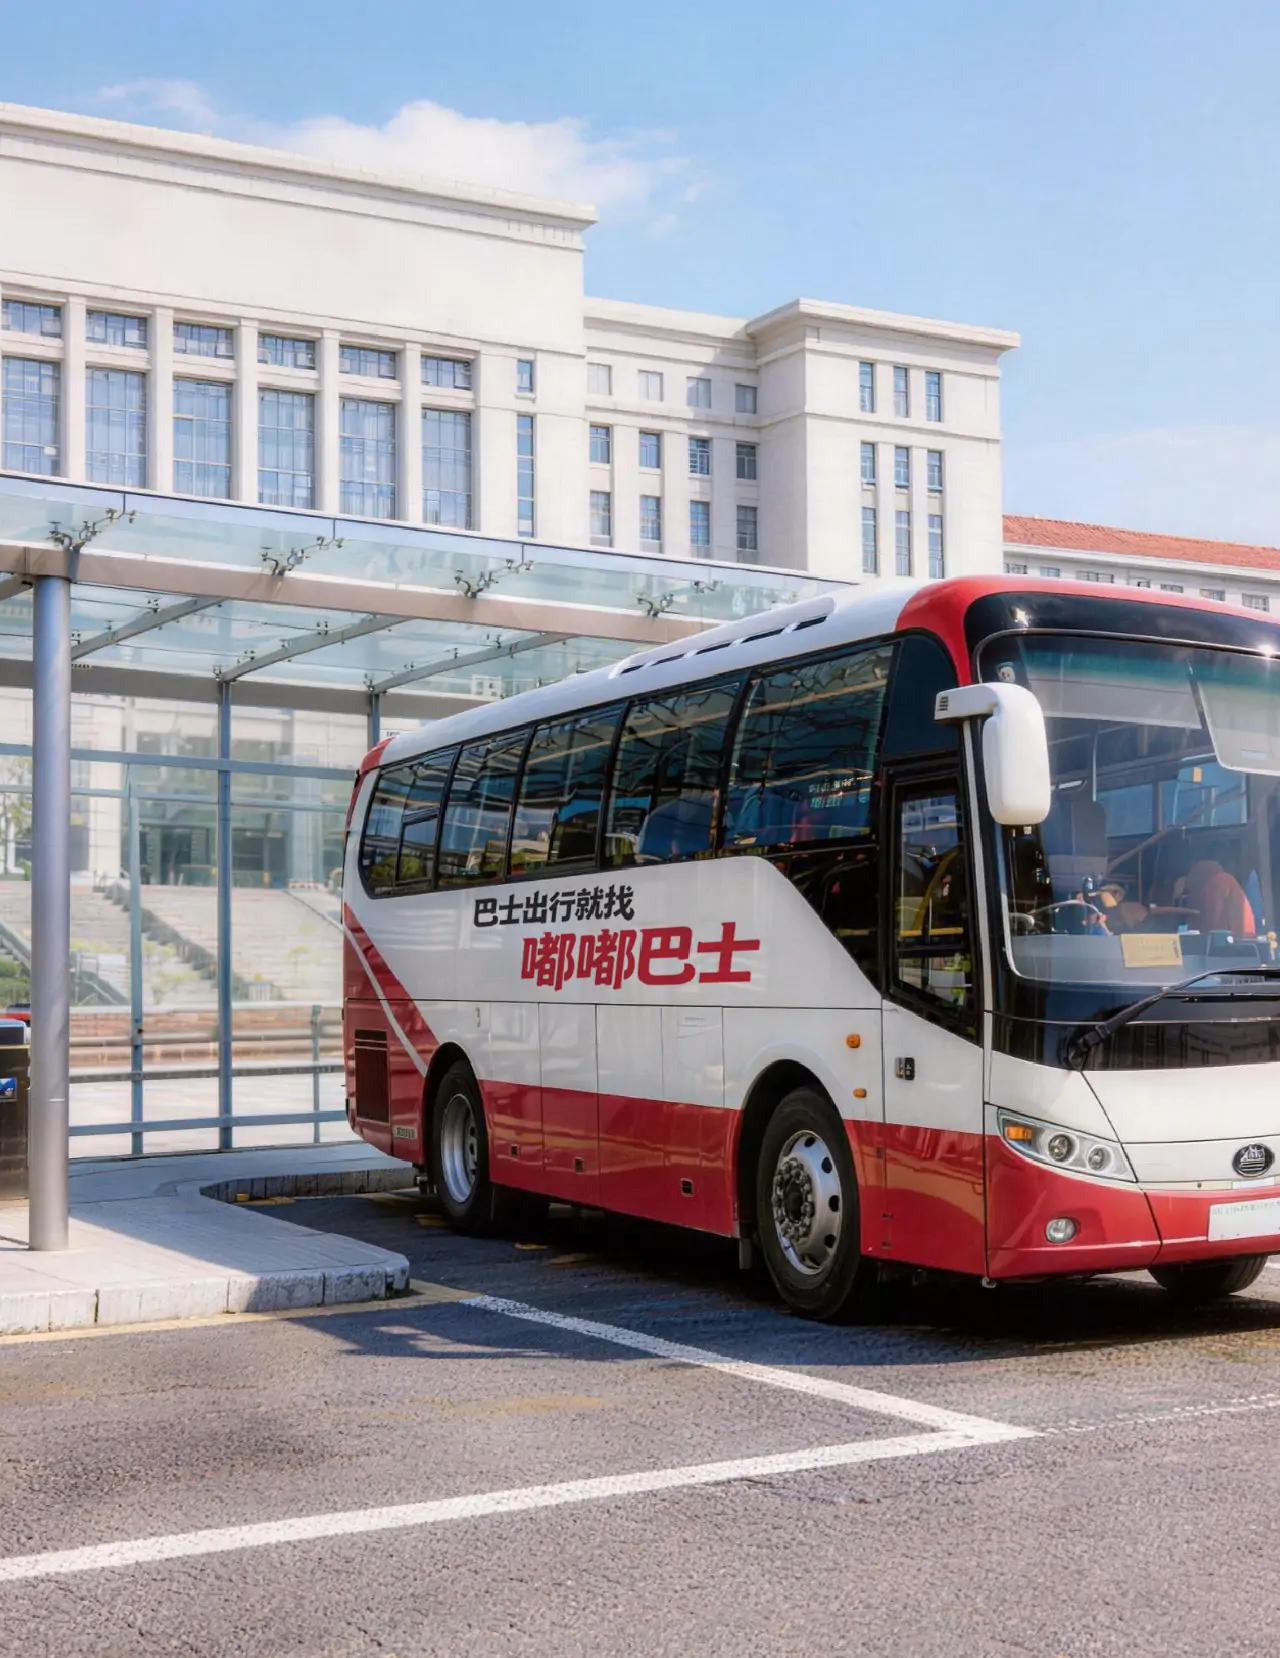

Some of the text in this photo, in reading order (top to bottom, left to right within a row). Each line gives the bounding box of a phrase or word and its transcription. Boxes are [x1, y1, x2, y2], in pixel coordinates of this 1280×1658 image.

[473, 884, 635, 927] 巴士出行就找
[521, 921, 760, 991] 嘟嘟巴士
